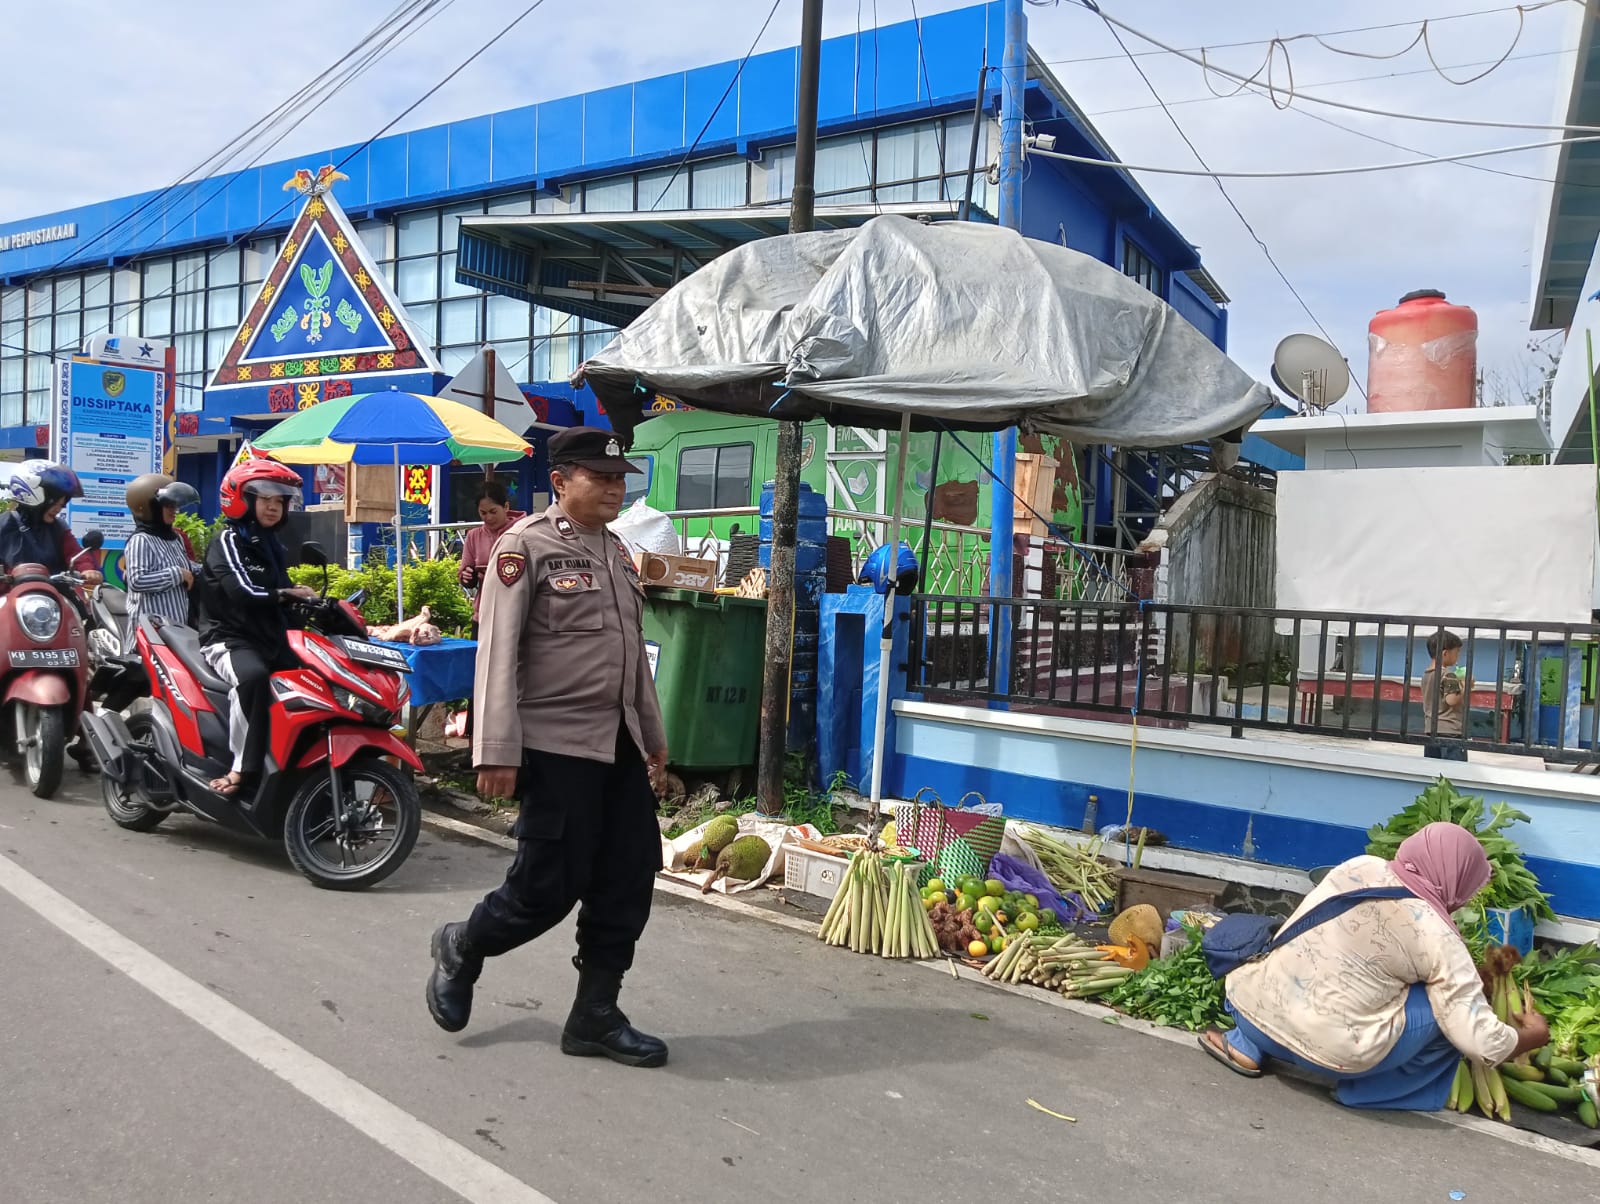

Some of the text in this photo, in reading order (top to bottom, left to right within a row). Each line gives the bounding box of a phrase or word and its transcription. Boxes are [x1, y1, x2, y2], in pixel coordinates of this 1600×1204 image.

[12, 223, 76, 249] PERPUSTAKAAN
[73, 396, 152, 414] DISSIPTAKA
[673, 572, 710, 587] ABC
[32, 651, 58, 660] 5195
[300, 674, 324, 692] HONDA
